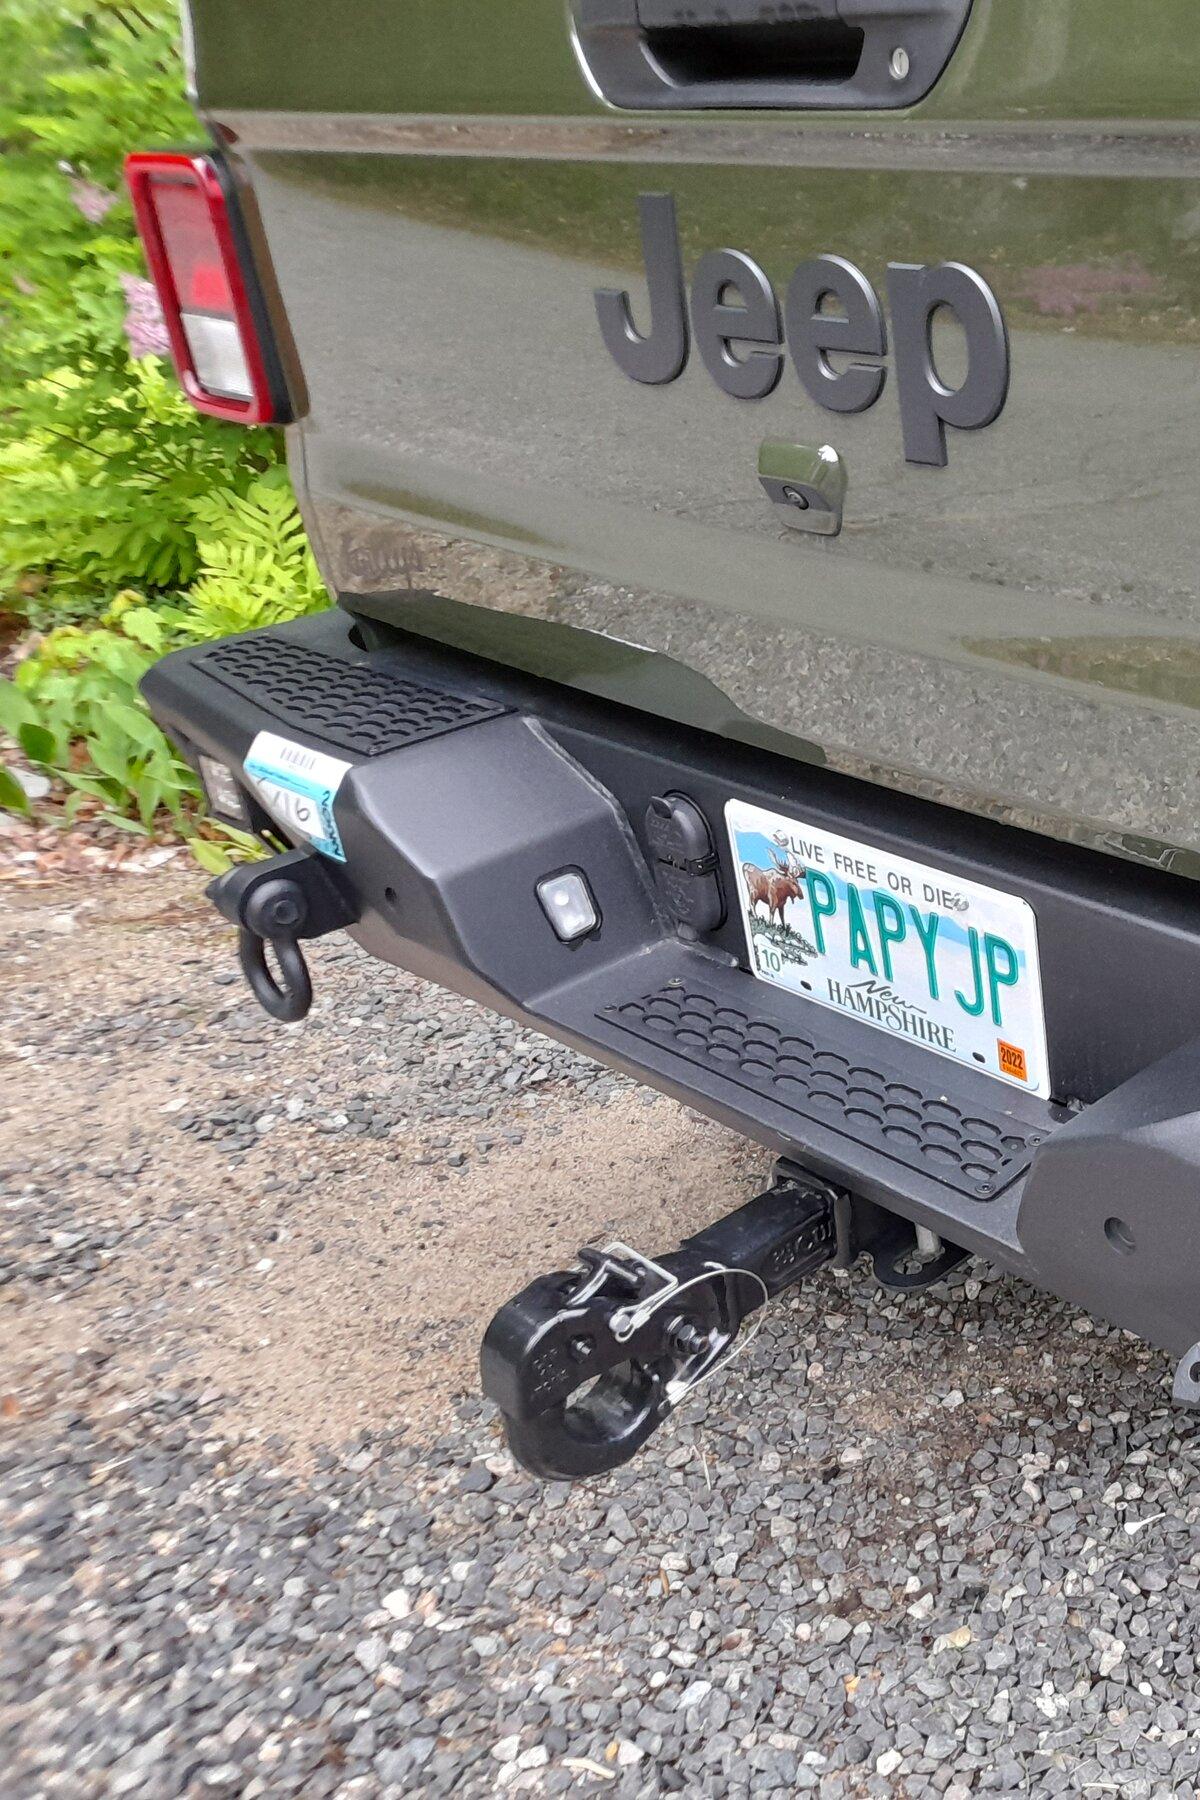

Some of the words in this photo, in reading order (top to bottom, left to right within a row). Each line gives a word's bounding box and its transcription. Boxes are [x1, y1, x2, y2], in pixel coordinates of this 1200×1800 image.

[594, 190, 1011, 467] Jeep
[790, 835, 825, 864] LIVE
[833, 852, 878, 884] FREE
[887, 871, 913, 897] OR
[923, 883, 954, 911] DIE
[761, 949, 781, 972] 10
[826, 977, 957, 1053] HAMPSHIRE
[847, 980, 927, 1014] New
[1000, 1046, 1024, 1071] 2022
